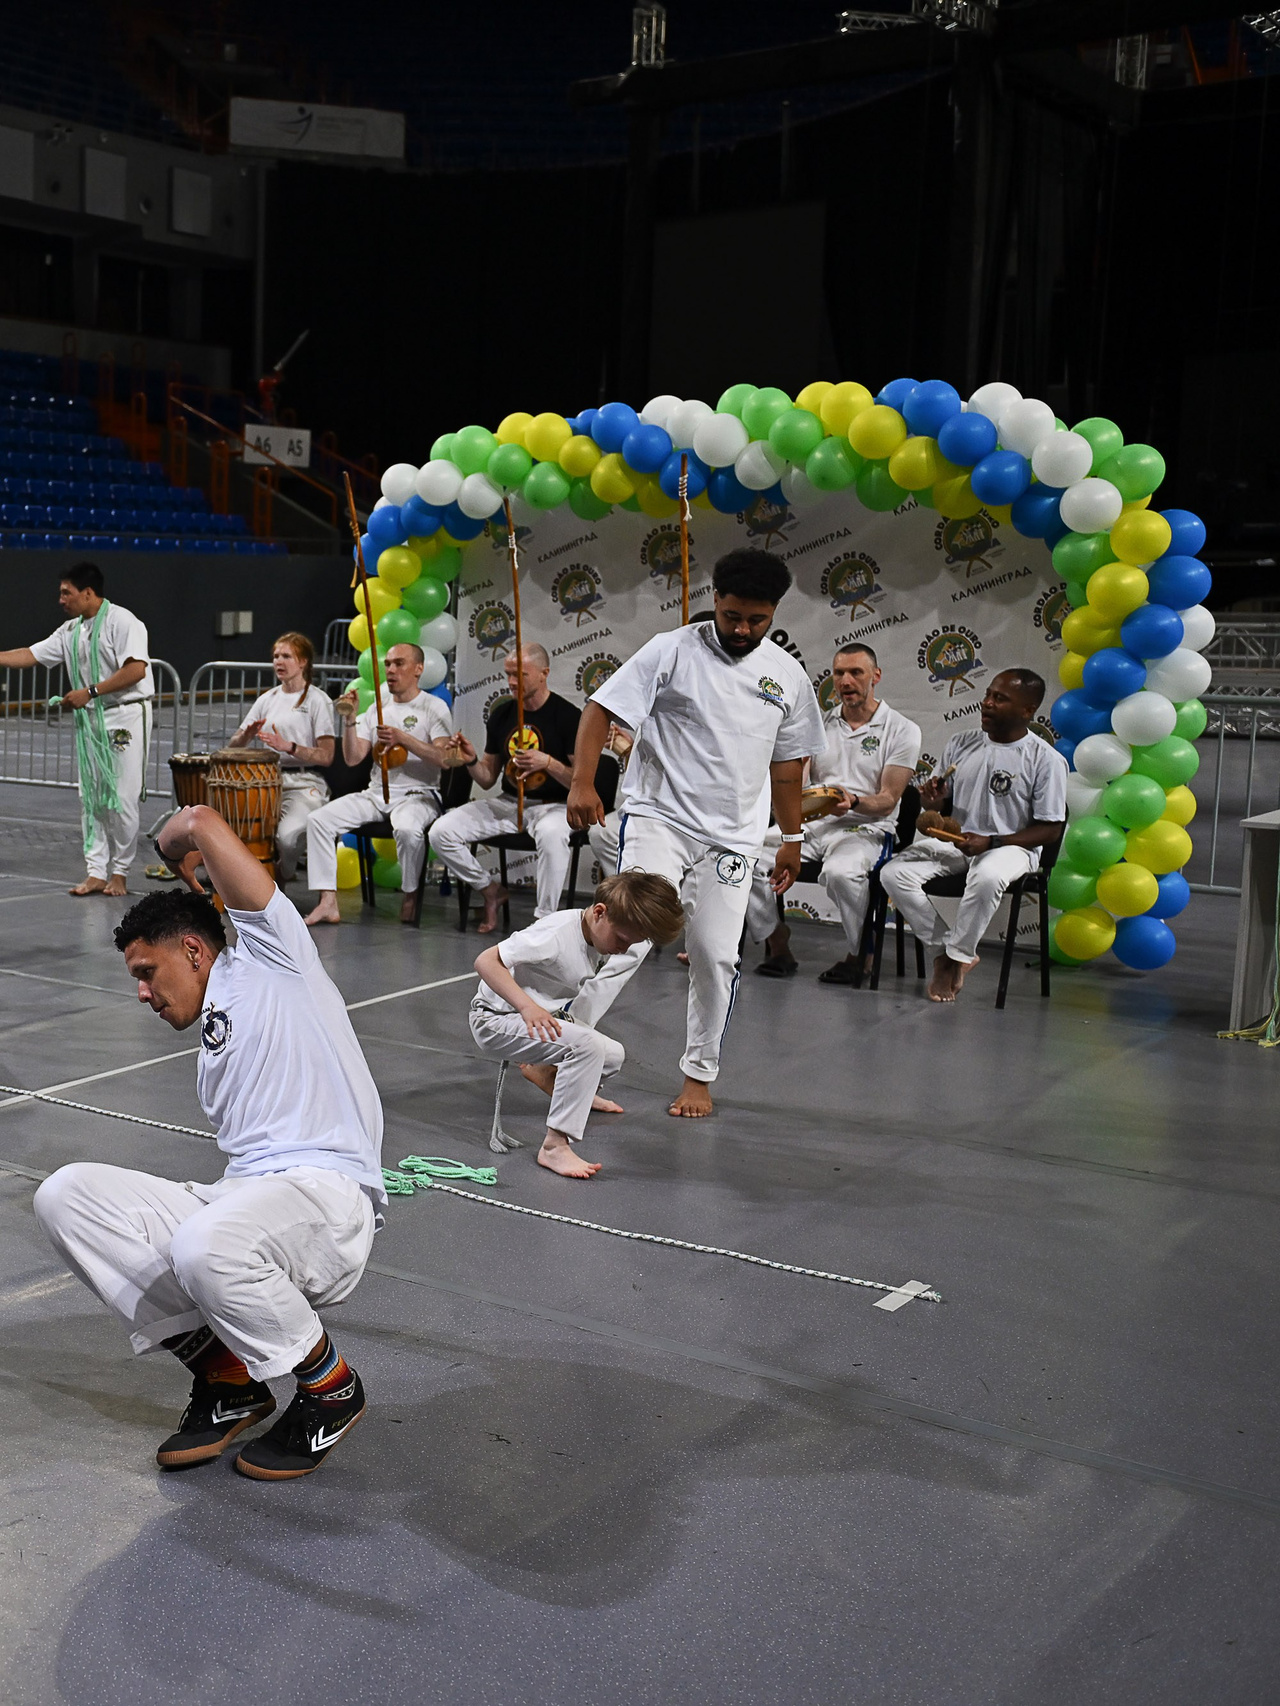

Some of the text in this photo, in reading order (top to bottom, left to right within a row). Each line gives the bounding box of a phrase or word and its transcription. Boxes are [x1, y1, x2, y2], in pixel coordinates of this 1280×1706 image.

[287, 438, 303, 457] A5
[660, 523, 672, 533] DE
[537, 532, 598, 564] КАЛИНИНГРАД
[780, 527, 852, 563] КАЛИНИНГРАД
[569, 563, 581, 571] DE
[583, 564, 602, 586] OURO
[843, 551, 856, 560] DE
[859, 552, 880, 575] OURO
[951, 566, 1033, 603] КАЛИНИНГРАД
[486, 600, 496, 608] DE
[497, 601, 515, 622] OURO
[834, 612, 908, 647] КАЛИНИНГРАД
[942, 624, 956, 633] DE
[958, 626, 982, 650] OURO
[551, 627, 613, 658] КАЛИНИНГРАД
[594, 652, 605, 660] DE
[606, 653, 623, 669] OUR
[787, 900, 821, 921] DE OUR
